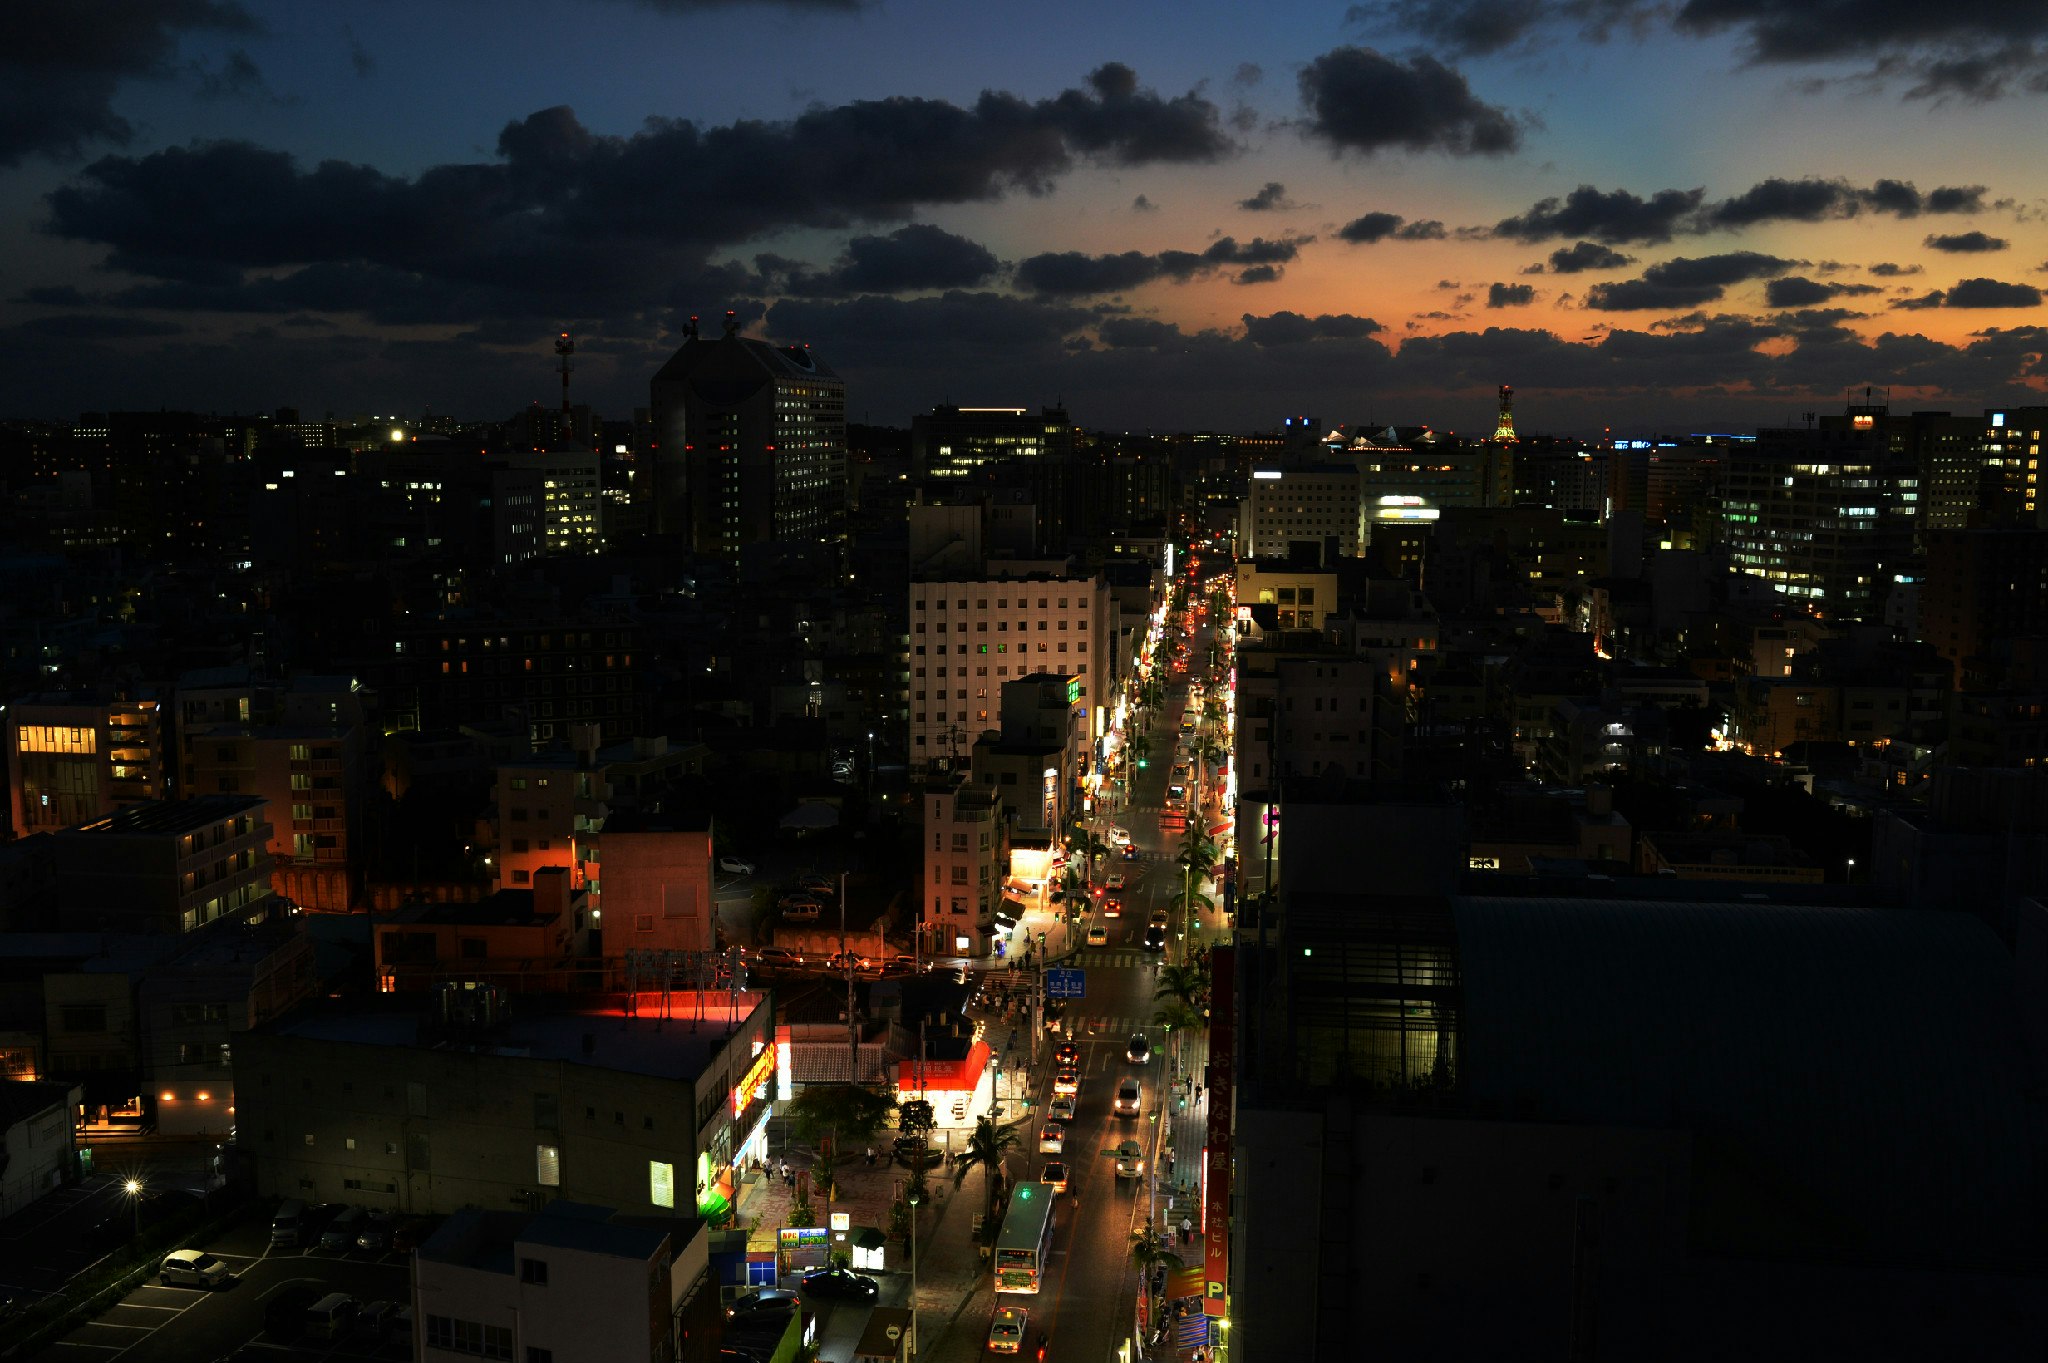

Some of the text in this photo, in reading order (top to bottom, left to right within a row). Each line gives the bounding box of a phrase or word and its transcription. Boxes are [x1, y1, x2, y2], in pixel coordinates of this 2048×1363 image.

[1209, 1050, 1230, 1171] おきなわ屋
[1210, 1201, 1224, 1258] 本社ビル
[1208, 1281, 1223, 1298] P
